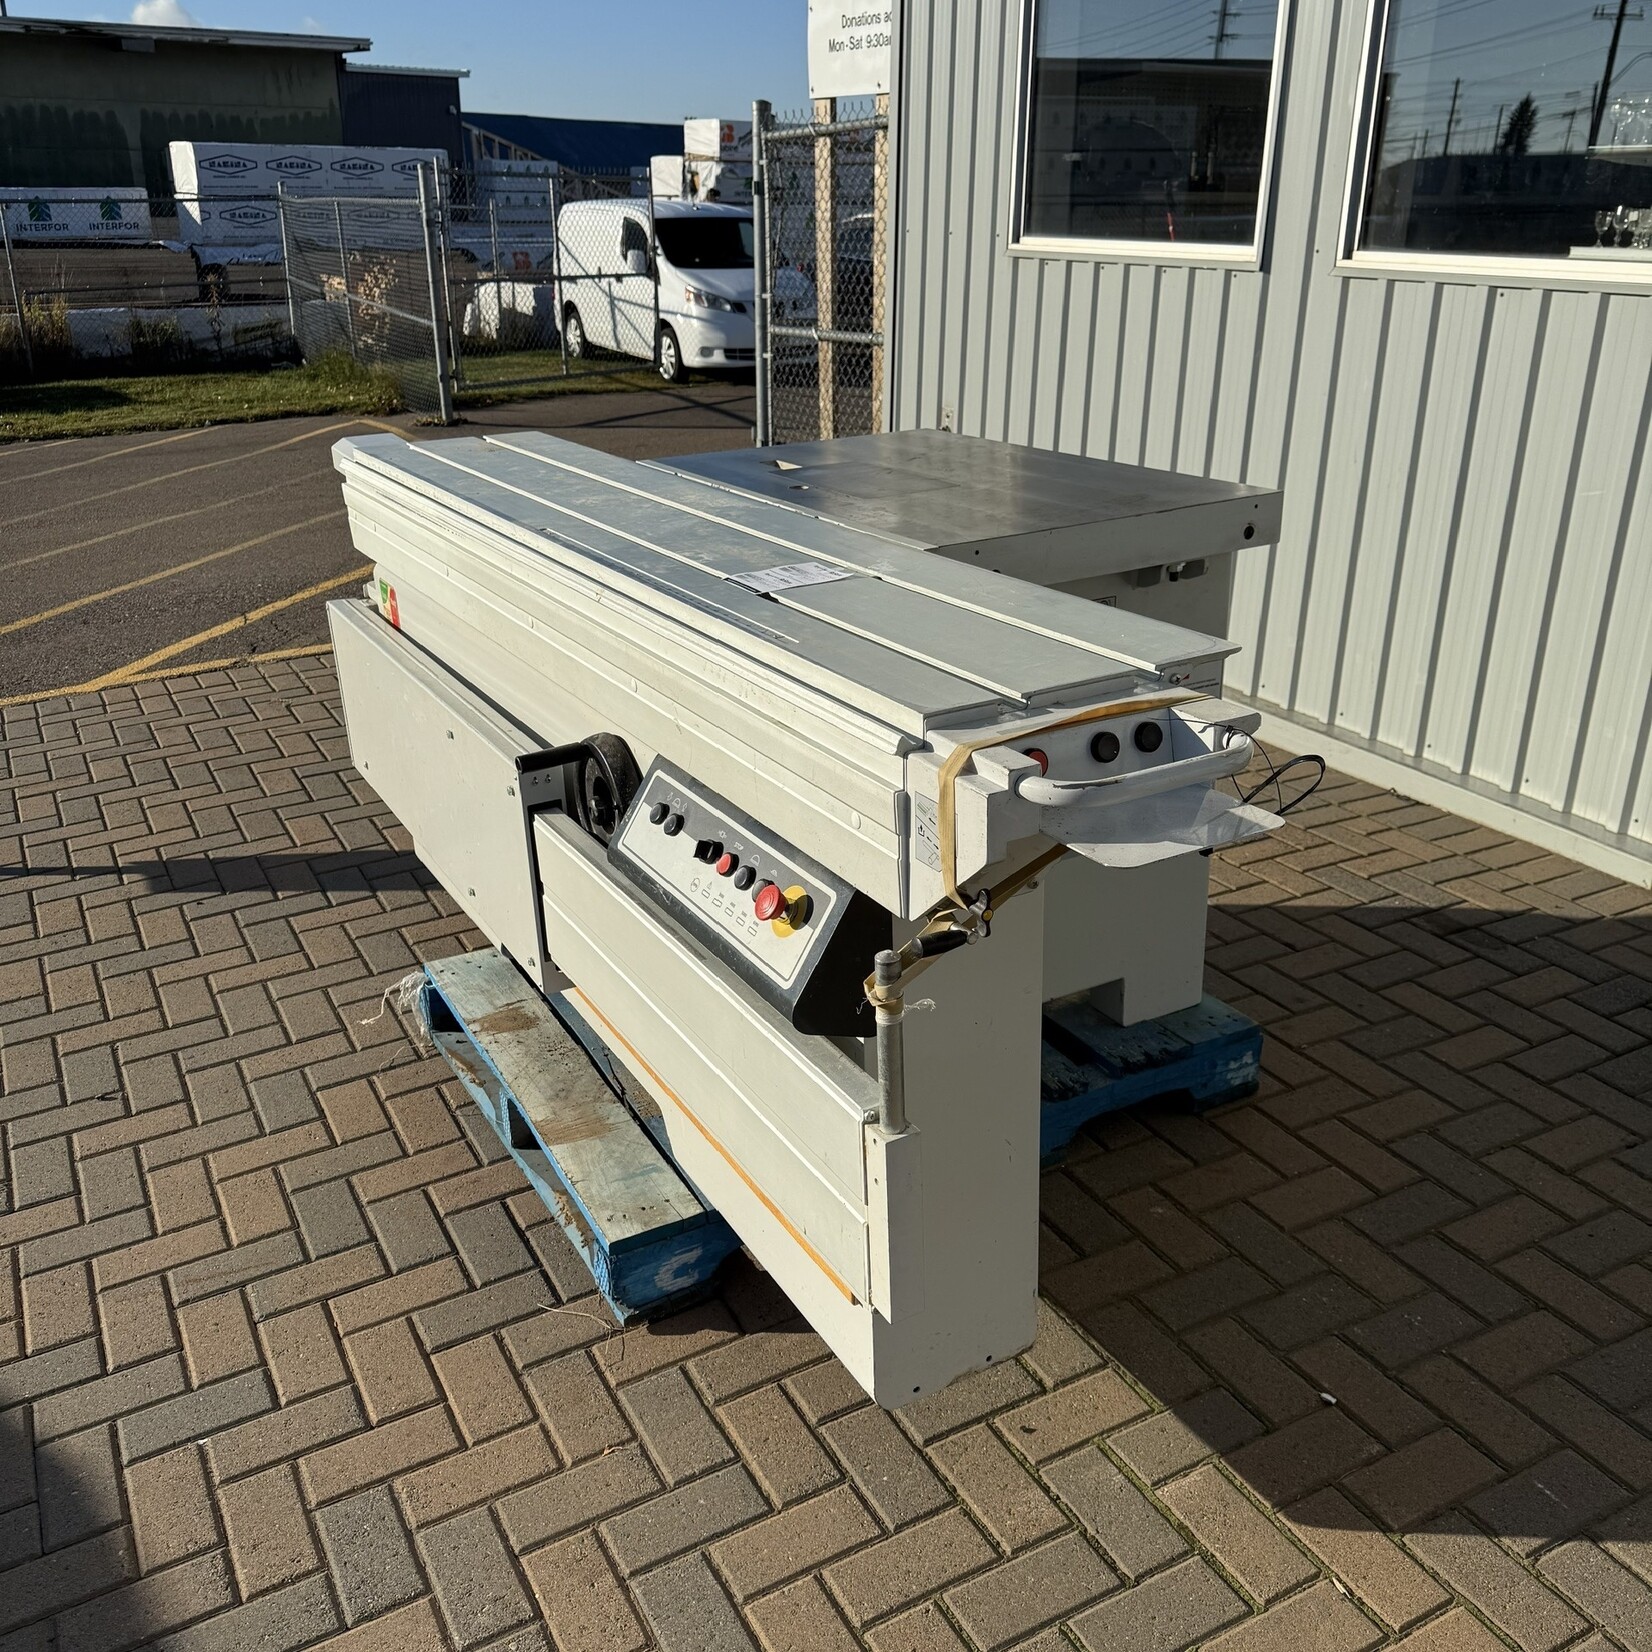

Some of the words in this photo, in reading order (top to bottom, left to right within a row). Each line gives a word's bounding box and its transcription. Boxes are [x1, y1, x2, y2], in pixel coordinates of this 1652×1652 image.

[841, 11, 881, 29] Donations
[16, 223, 69, 232] INTERFOR
[89, 222, 139, 231] INTERFOR
